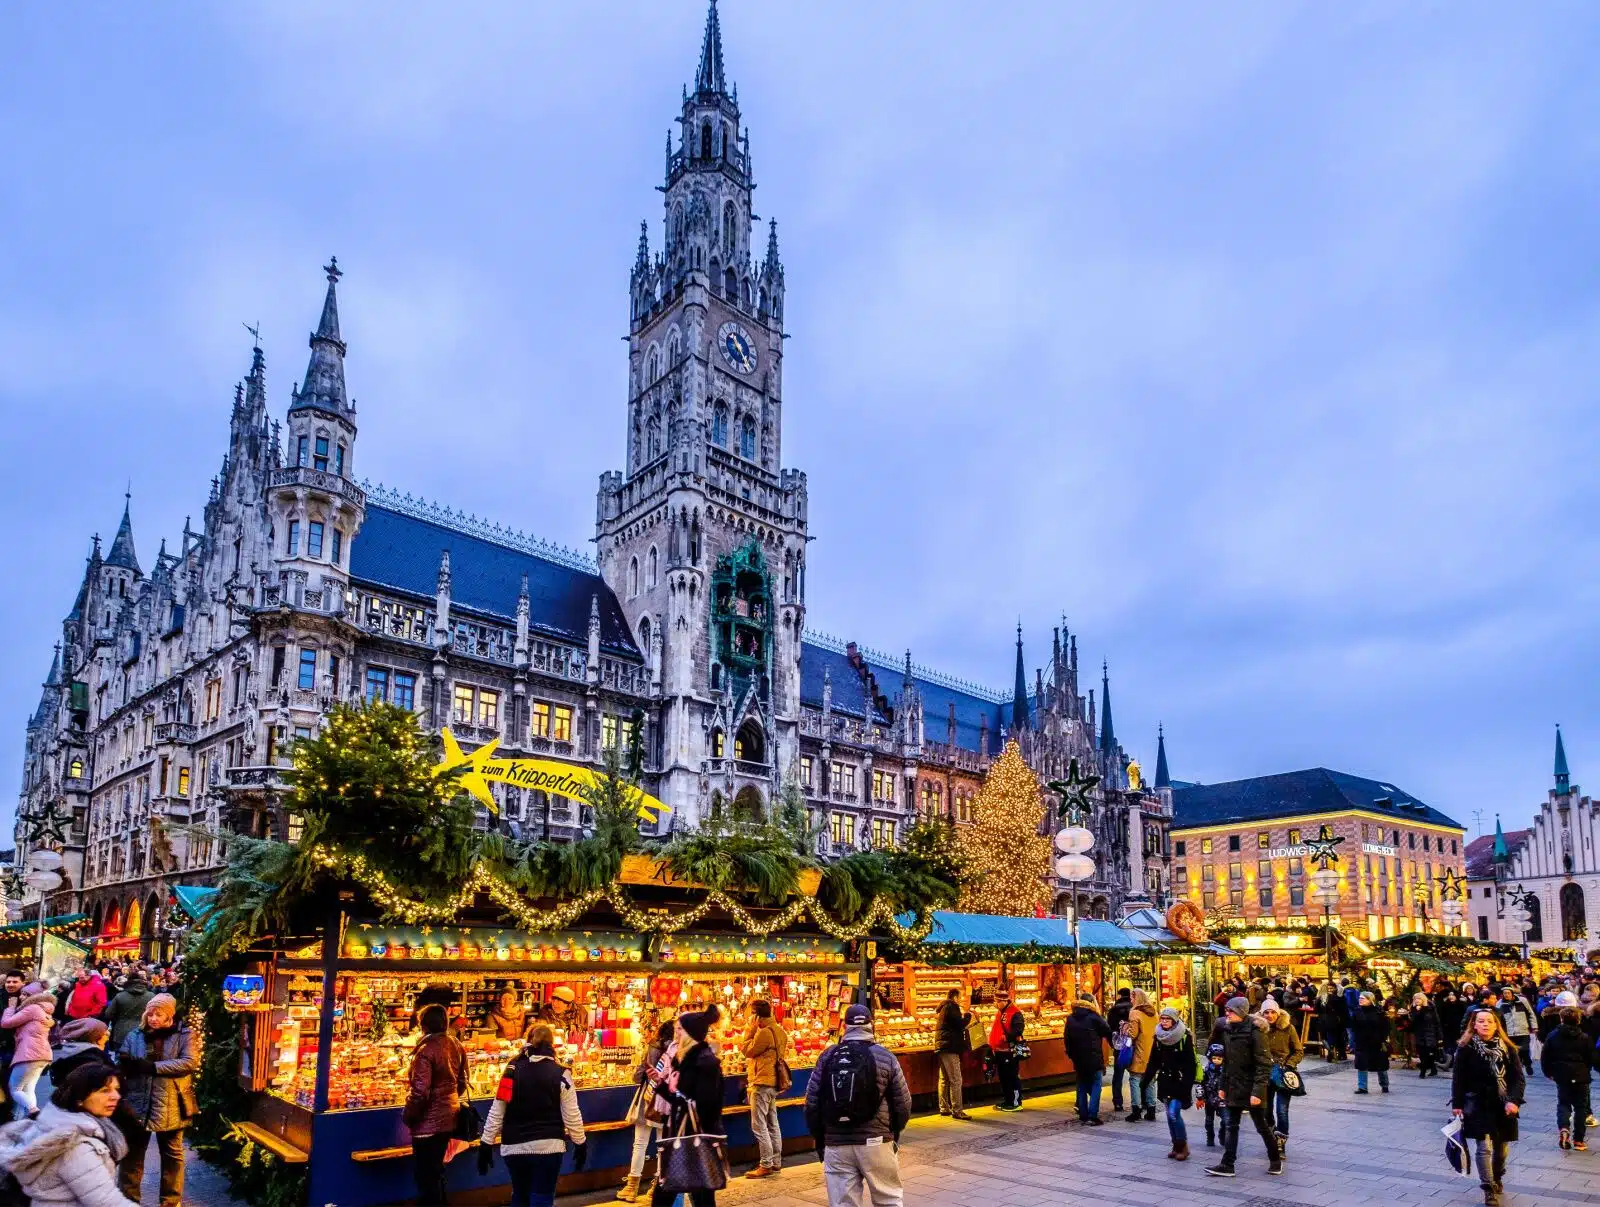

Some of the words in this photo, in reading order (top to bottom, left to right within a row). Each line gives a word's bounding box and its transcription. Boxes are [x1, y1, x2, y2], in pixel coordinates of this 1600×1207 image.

[481, 765, 504, 776] zum
[1268, 846, 1307, 858] LUDWIG
[1362, 843, 1381, 854] LUDWIG
[1382, 846, 1395, 856] BECK
